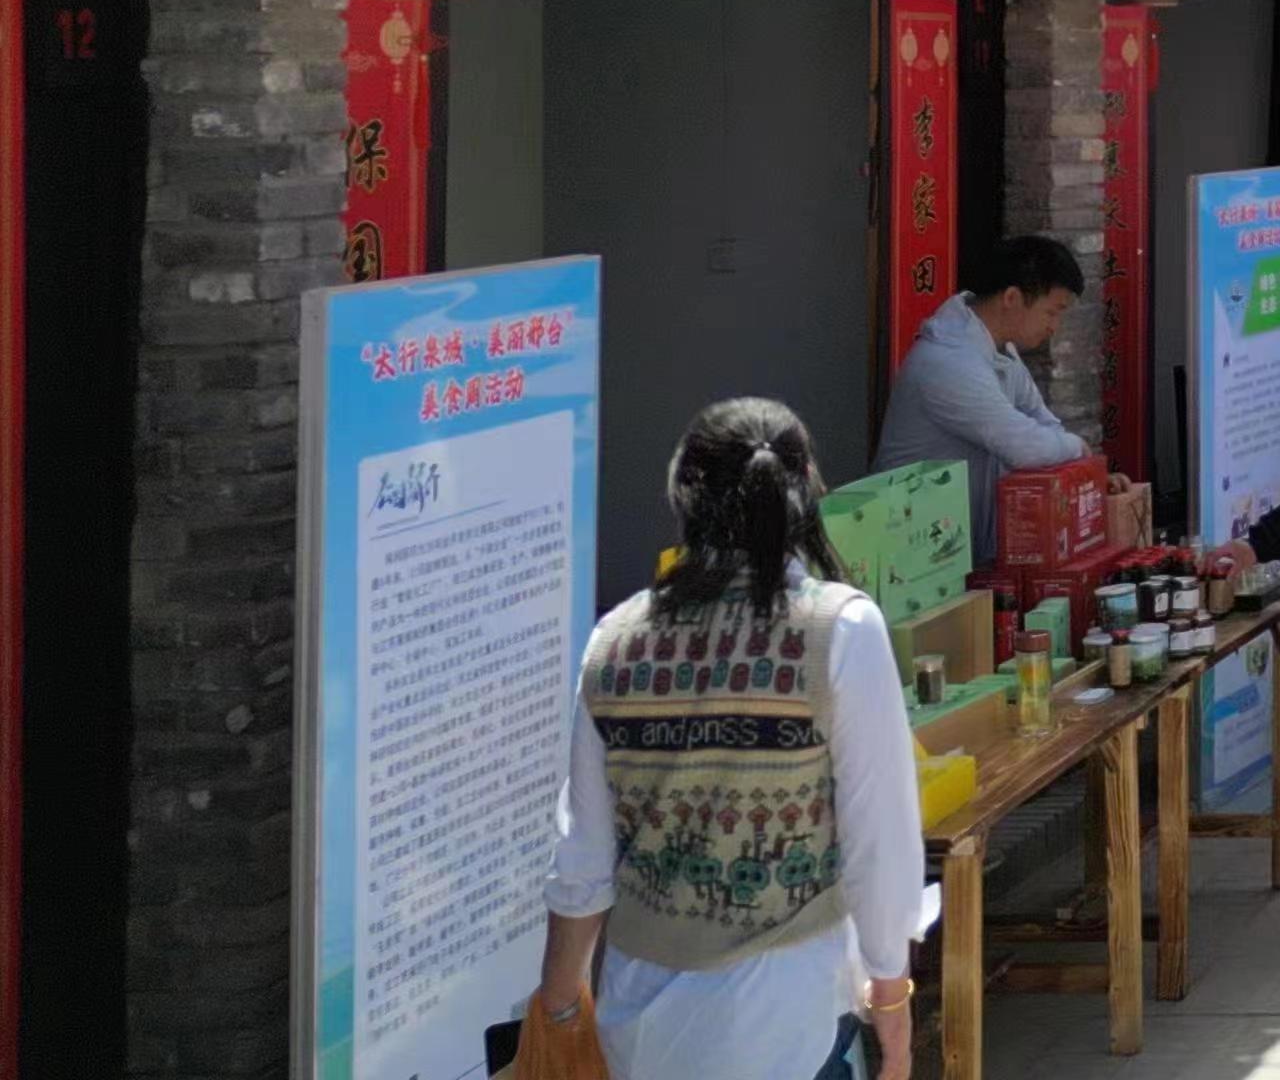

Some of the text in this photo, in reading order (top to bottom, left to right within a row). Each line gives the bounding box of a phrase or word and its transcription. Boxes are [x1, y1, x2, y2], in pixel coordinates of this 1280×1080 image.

[420, 367, 525, 420] 美食周活动
